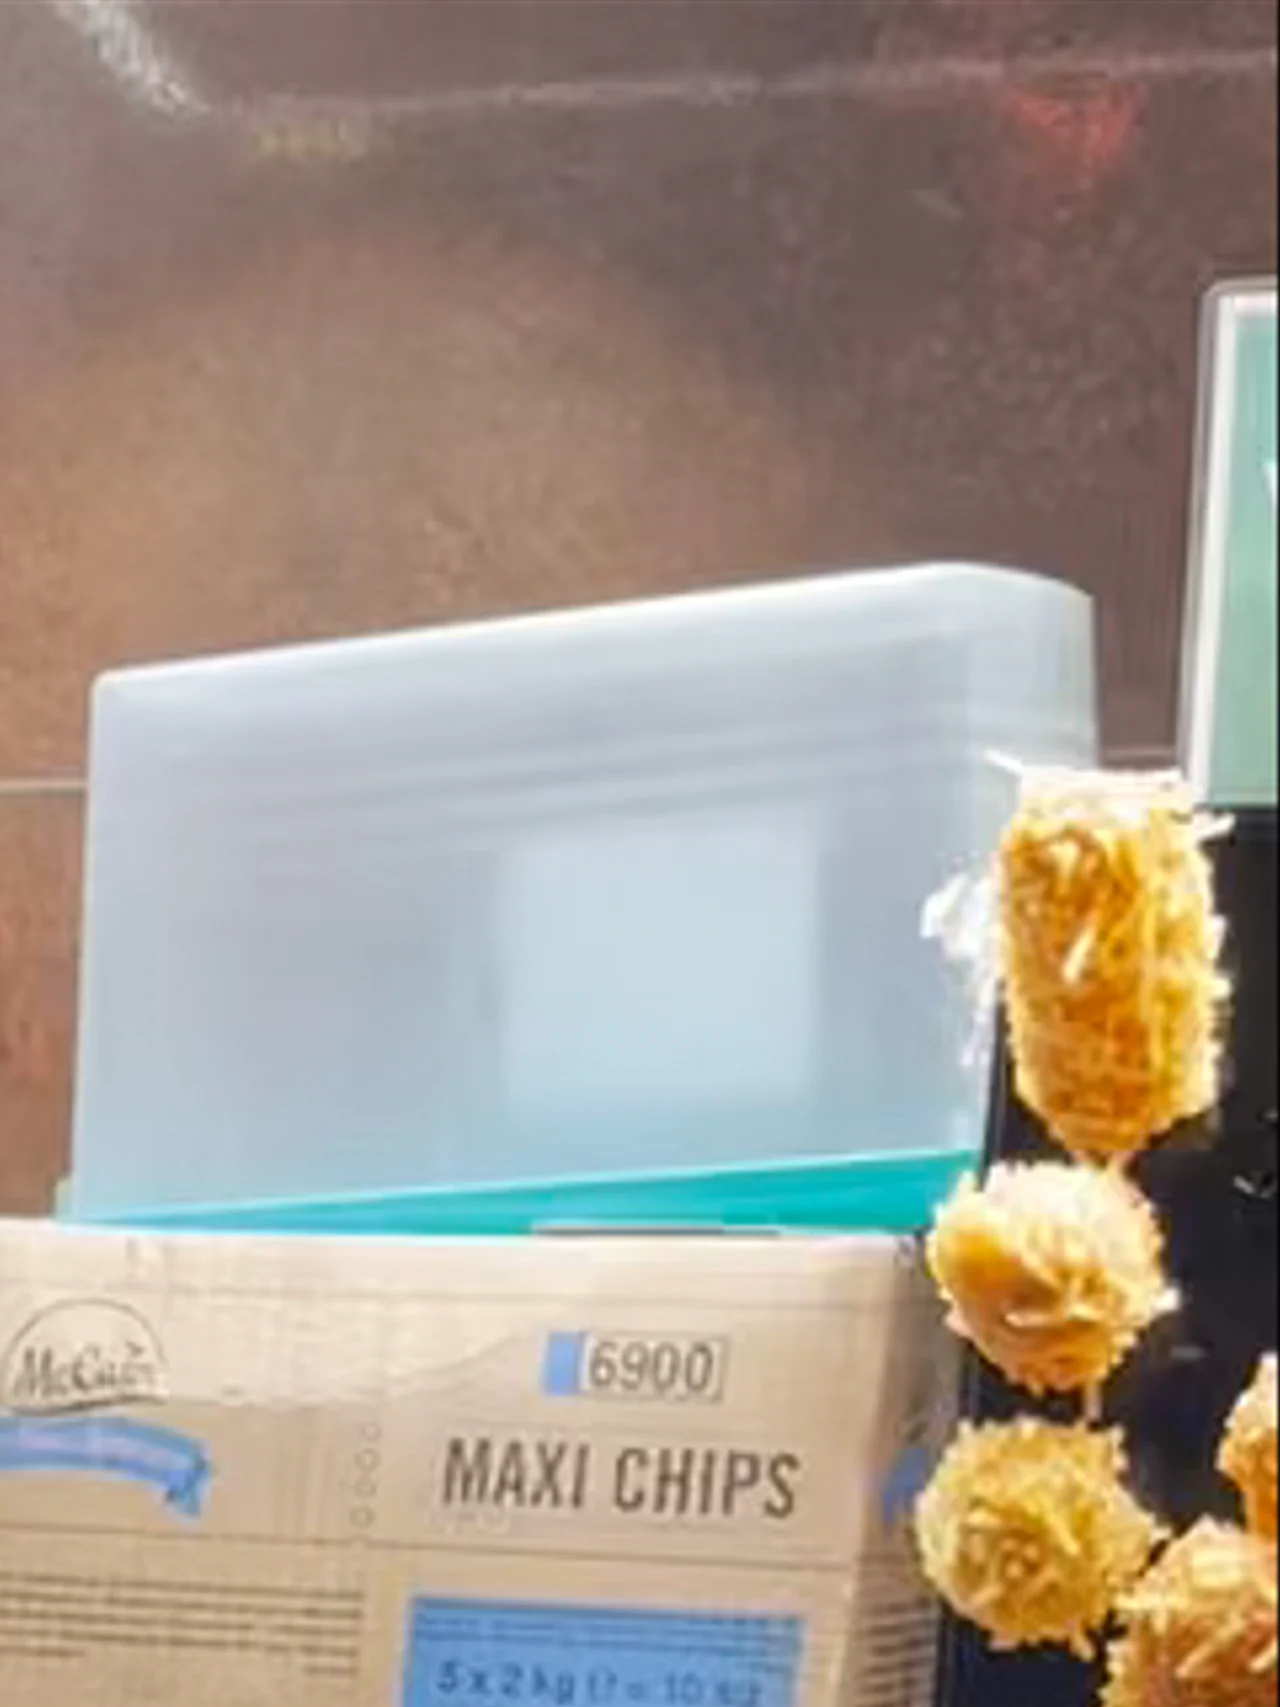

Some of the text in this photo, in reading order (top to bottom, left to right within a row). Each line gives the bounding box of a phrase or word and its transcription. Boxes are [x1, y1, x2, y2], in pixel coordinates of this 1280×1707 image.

[588, 1340, 716, 1394] 6900
[443, 1436, 802, 1520] MAXI CHIPS
[501, 1663, 524, 1698] 2
